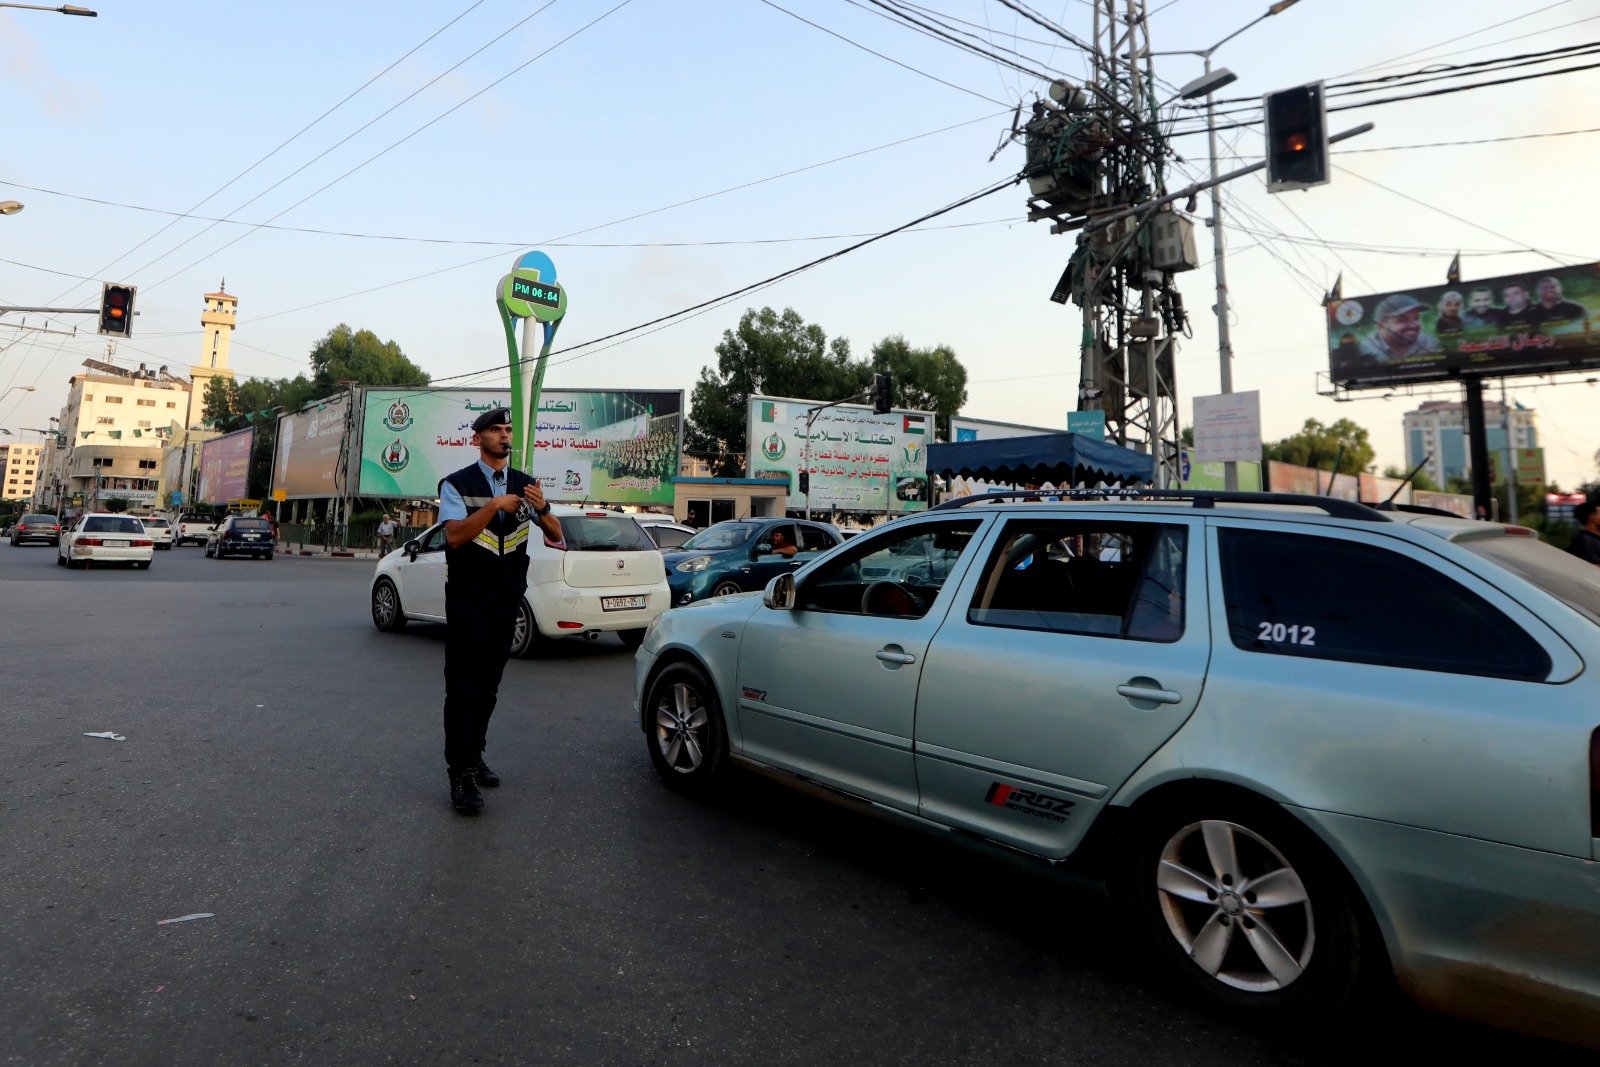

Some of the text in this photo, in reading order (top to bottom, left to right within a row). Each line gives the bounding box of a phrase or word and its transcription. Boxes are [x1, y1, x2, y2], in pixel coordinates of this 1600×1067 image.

[515, 282, 530, 294] PM
[538, 400, 577, 412] الكتل
[457, 421, 469, 431] من
[436, 435, 467, 447] العامة
[794, 427, 896, 445] الكتلة الإسلامية
[570, 438, 601, 451] الطلبة
[814, 449, 832, 461] قطاع
[834, 451, 850, 461] طلبة
[869, 453, 889, 463] تكرم
[821, 465, 846, 476] الثانوية
[848, 466, 857, 479] في
[1257, 621, 1316, 646] 2012
